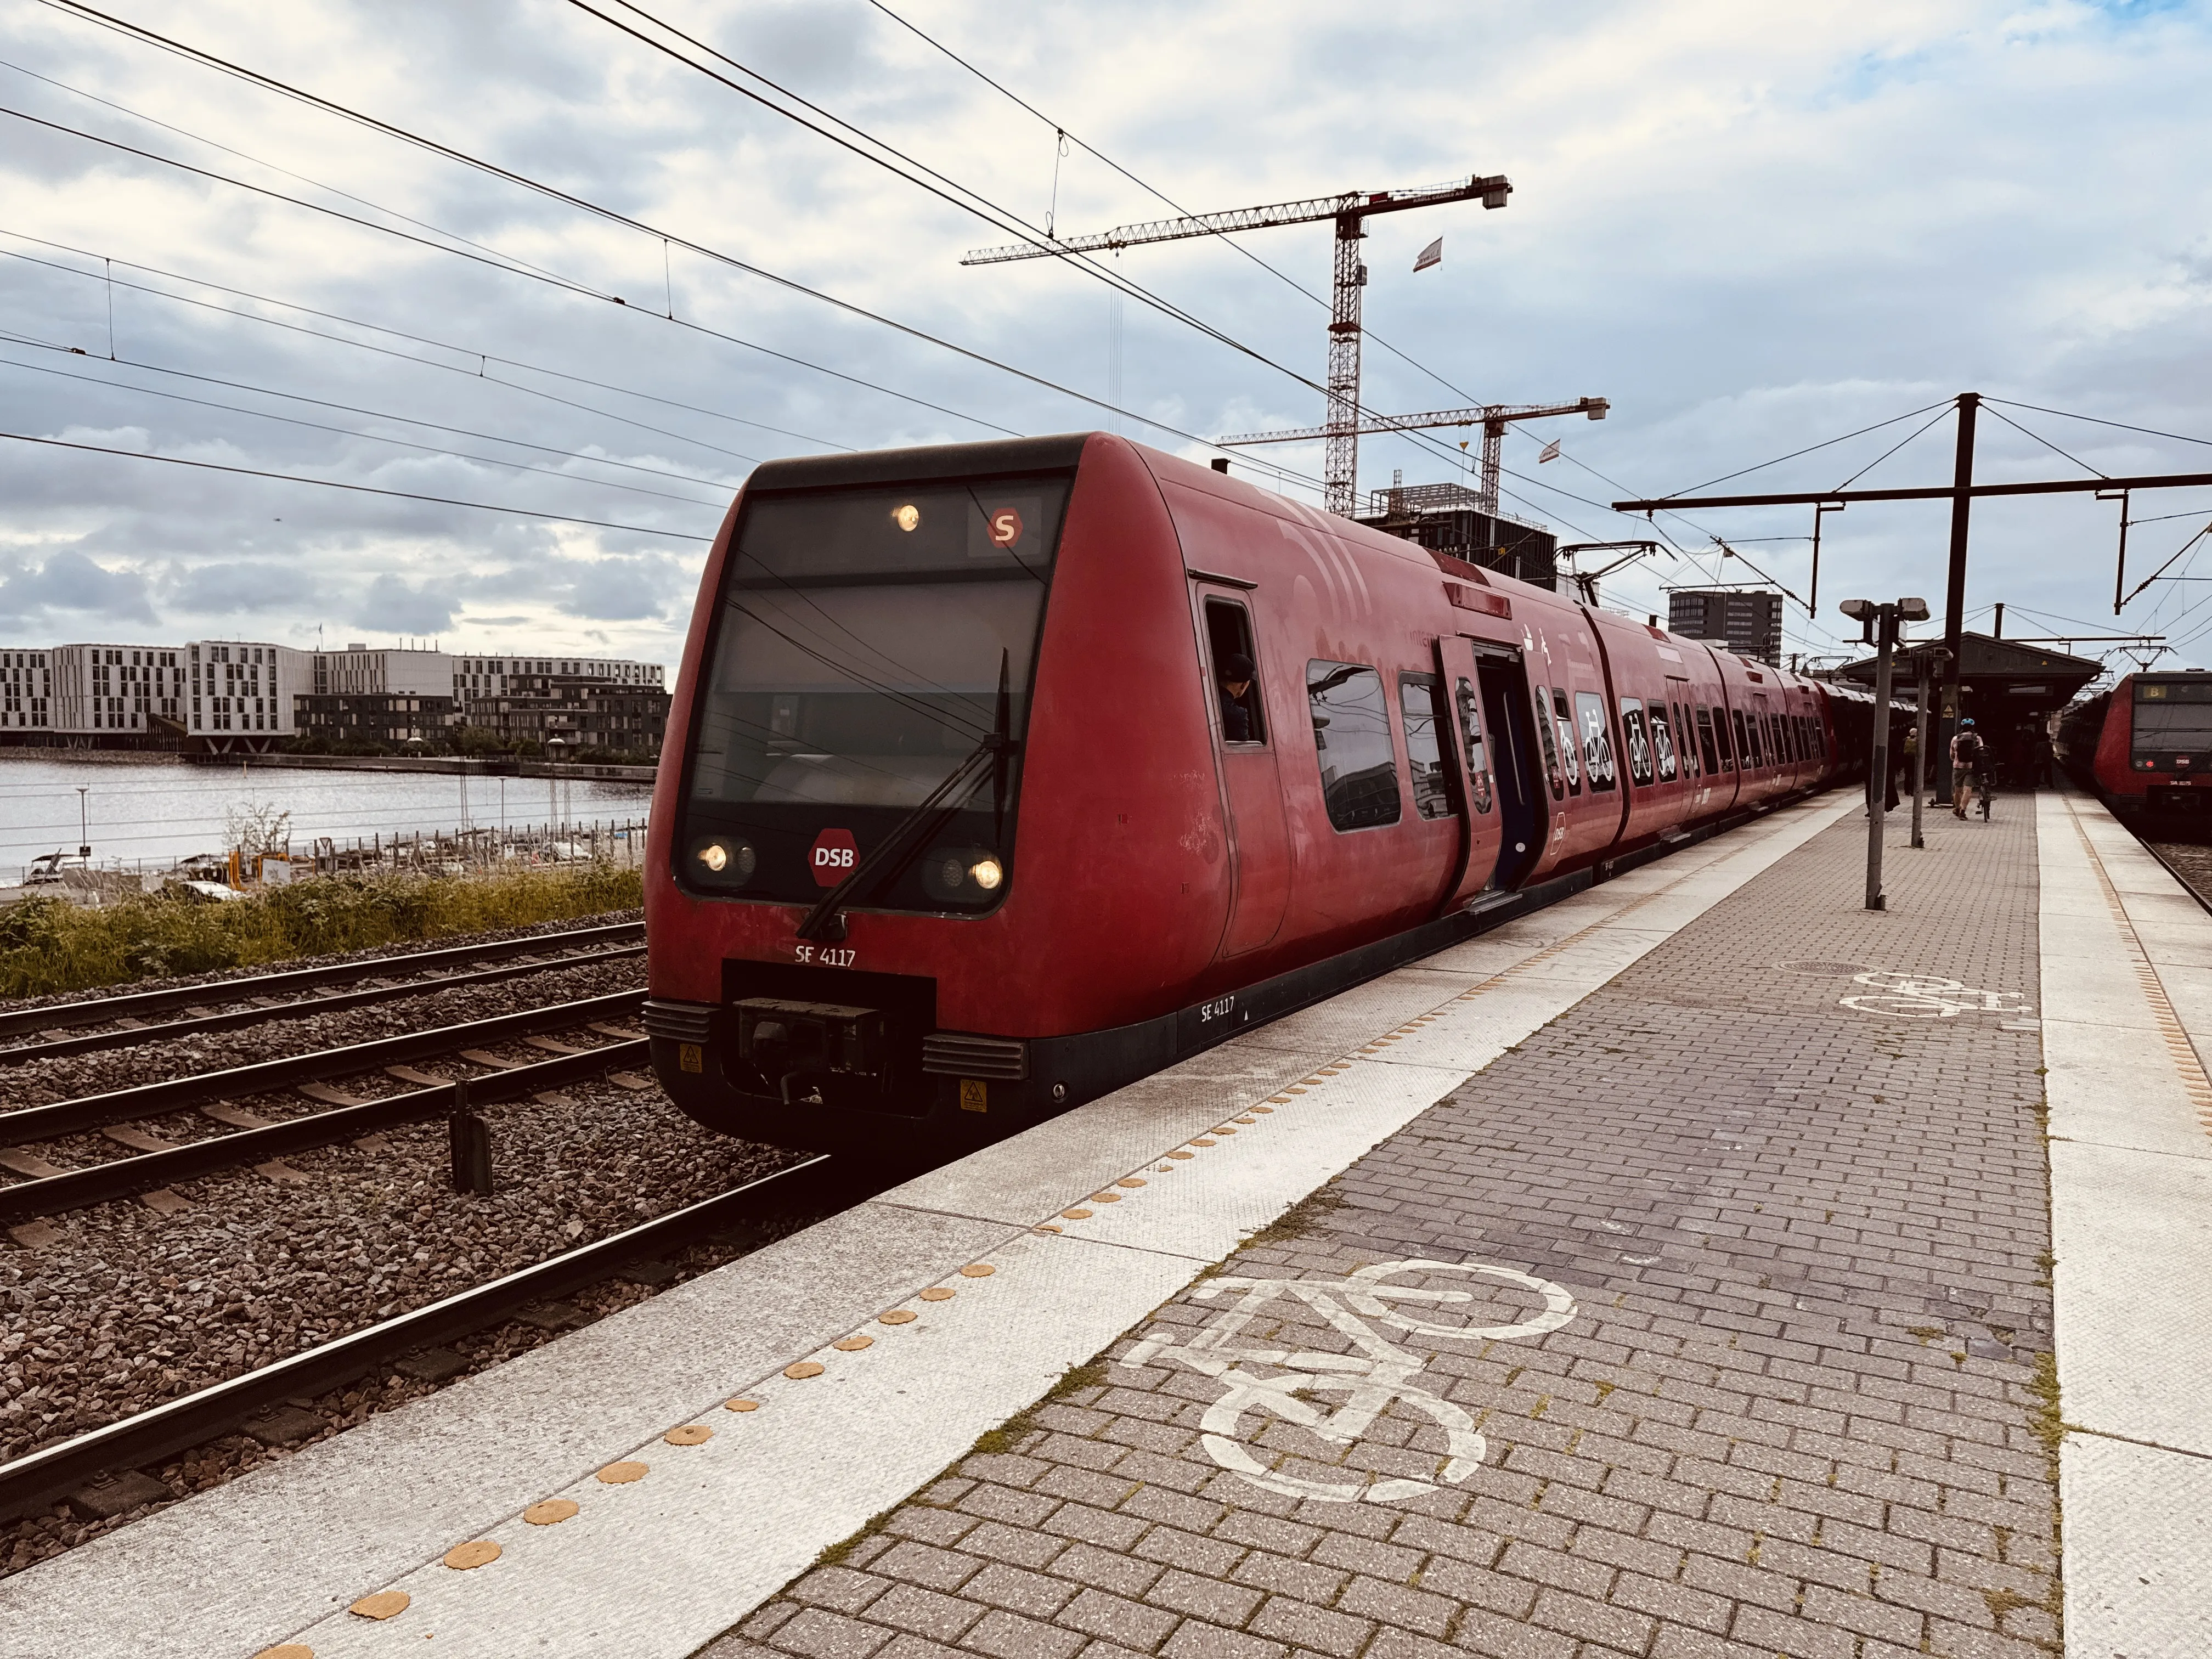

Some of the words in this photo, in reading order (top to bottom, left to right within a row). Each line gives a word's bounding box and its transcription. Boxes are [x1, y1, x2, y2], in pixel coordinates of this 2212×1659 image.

[995, 515, 1014, 541] S
[2151, 687, 2159, 697] B
[1554, 827, 1564, 841] DSB
[815, 848, 854, 867] DSB
[795, 945, 814, 963] SE
[820, 948, 856, 967] 4117
[1201, 1003, 1212, 1022] SE
[1214, 995, 1234, 1016] 4117
